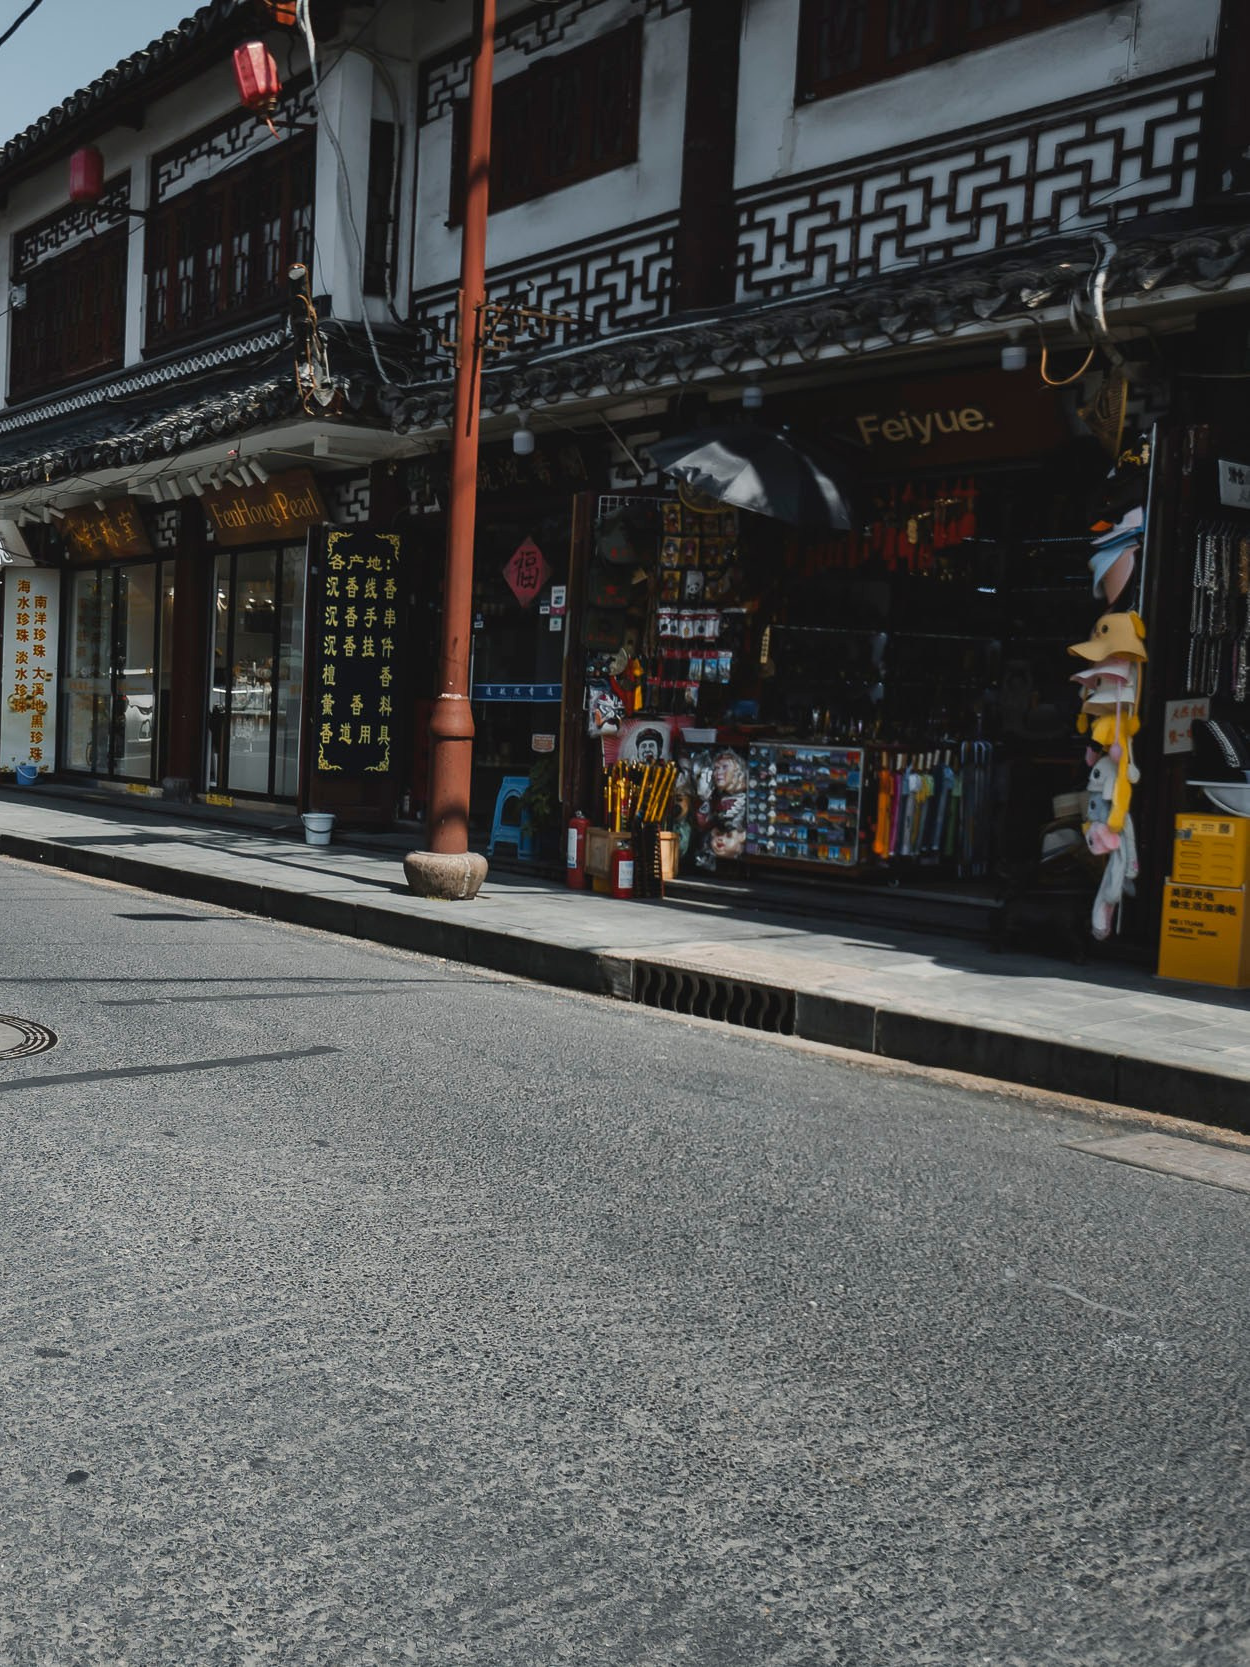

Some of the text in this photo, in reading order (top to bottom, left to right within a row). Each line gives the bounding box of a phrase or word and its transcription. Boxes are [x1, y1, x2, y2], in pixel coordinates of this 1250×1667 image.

[855, 407, 995, 447] Feiyue.
[210, 488, 320, 528] FenHong Pearl
[326, 576, 398, 600] 沉香线香
[513, 550, 539, 590] 福
[324, 606, 397, 630] 沉香手串
[13, 580, 31, 714] 海水珍珠 淡水珍珠
[322, 636, 395, 659] 沉香挂件
[30, 595, 48, 762] 南洋珍珠 大溪地黑珍珠
[319, 723, 391, 746] 香道用具
